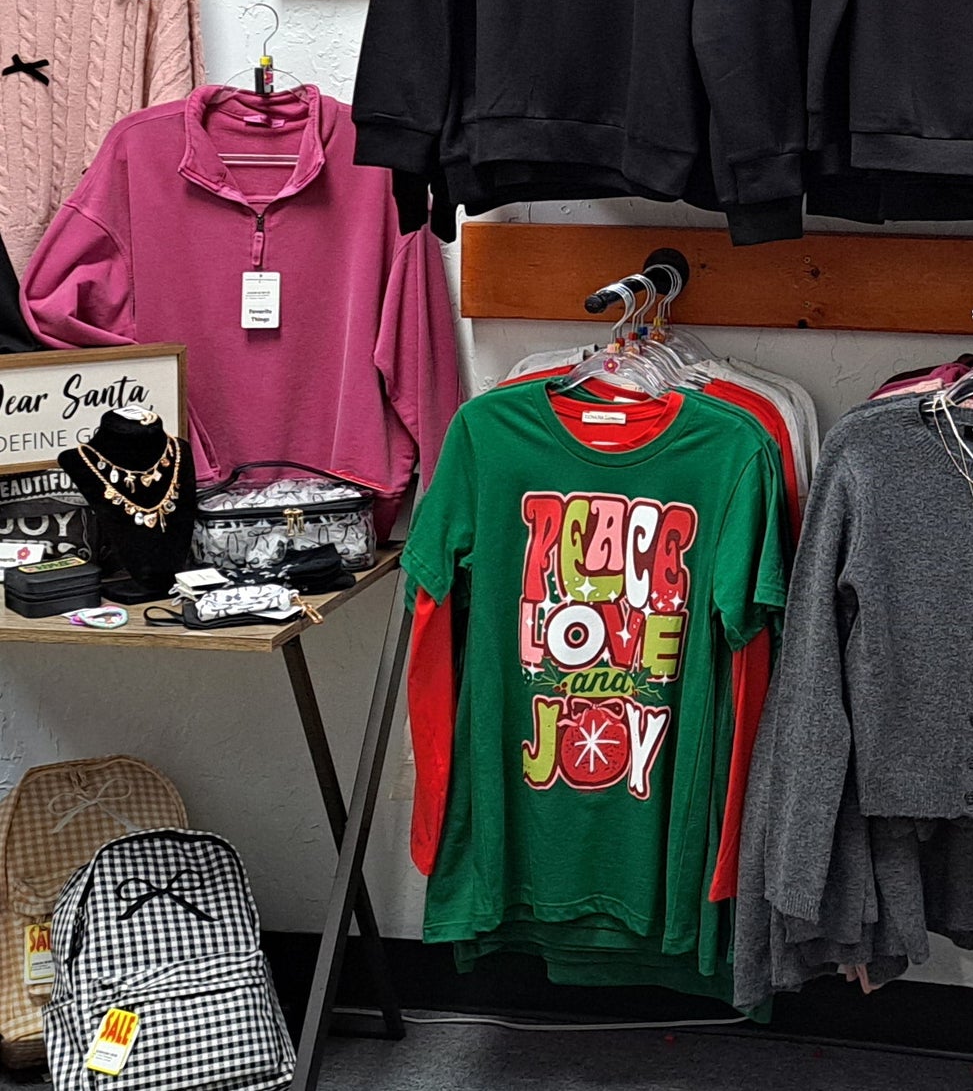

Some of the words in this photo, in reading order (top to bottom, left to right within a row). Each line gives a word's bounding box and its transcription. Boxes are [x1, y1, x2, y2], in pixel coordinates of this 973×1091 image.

[0, 383, 48, 416] ear
[521, 491, 698, 613] PEACE
[520, 601, 689, 683] LOVE
[570, 667, 633, 694] and
[522, 694, 672, 800] JOY
[100, 1011, 136, 1046] SALE
